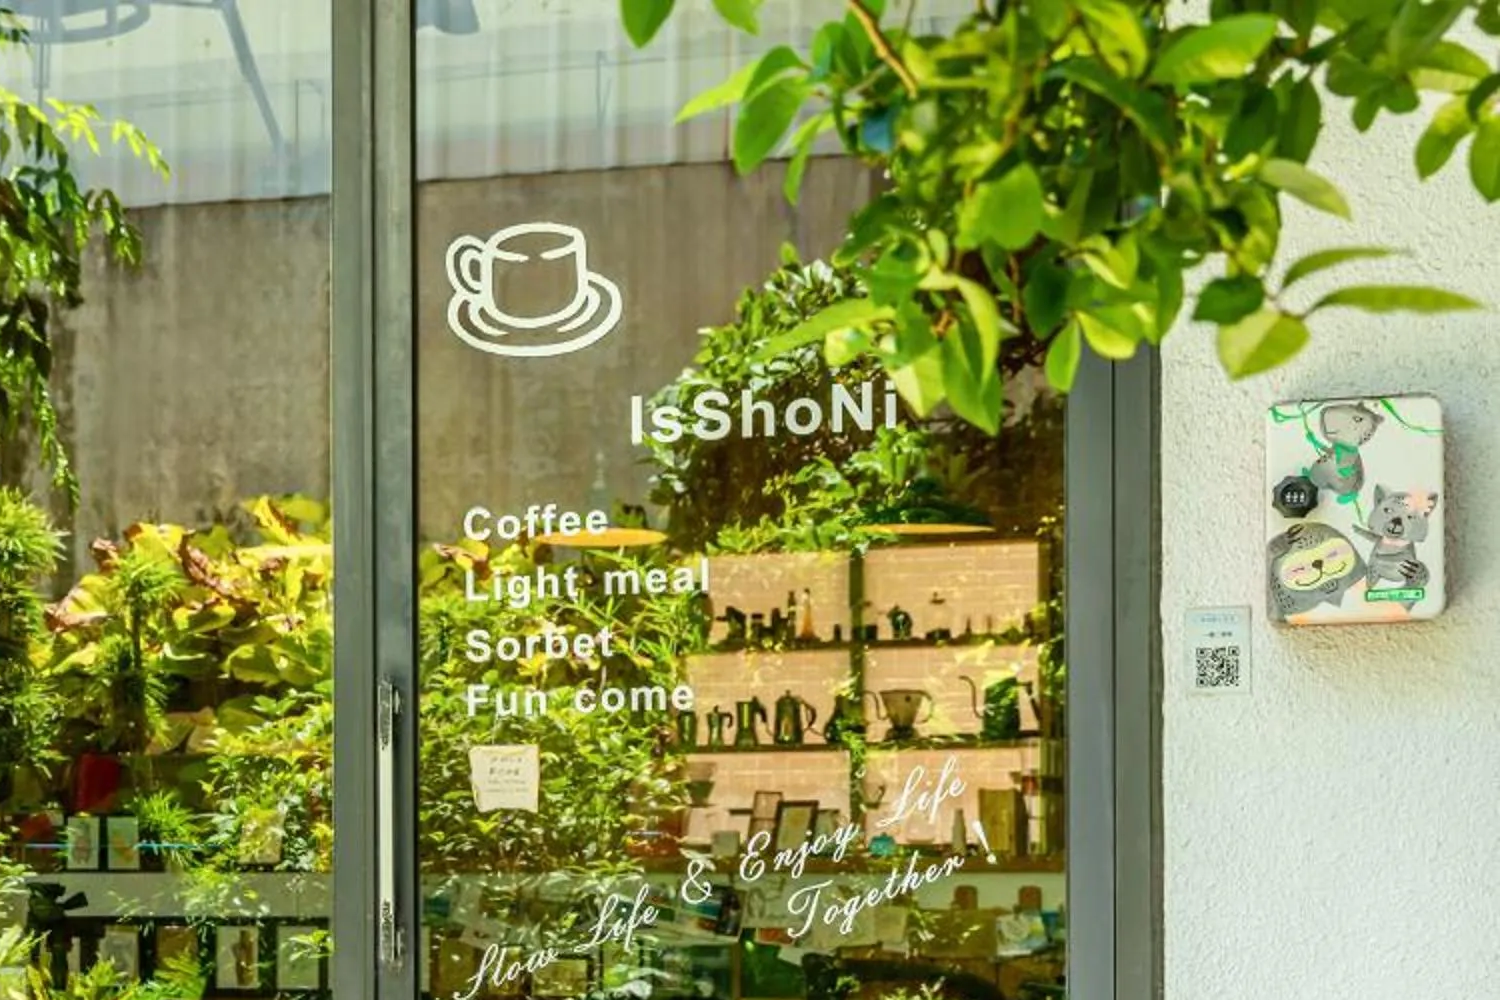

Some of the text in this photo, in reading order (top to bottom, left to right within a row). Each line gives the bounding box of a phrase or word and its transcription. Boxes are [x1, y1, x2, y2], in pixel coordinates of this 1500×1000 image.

[631, 379, 900, 445] IsShoNi
[463, 504, 609, 541] Coffee
[464, 558, 710, 608] Light meal
[464, 627, 613, 663] Sorbet
[466, 681, 695, 718] Fun come
[575, 884, 660, 955] Life
[680, 858, 714, 905] &
[739, 822, 860, 883] Enjoy
[879, 754, 967, 829] Life
